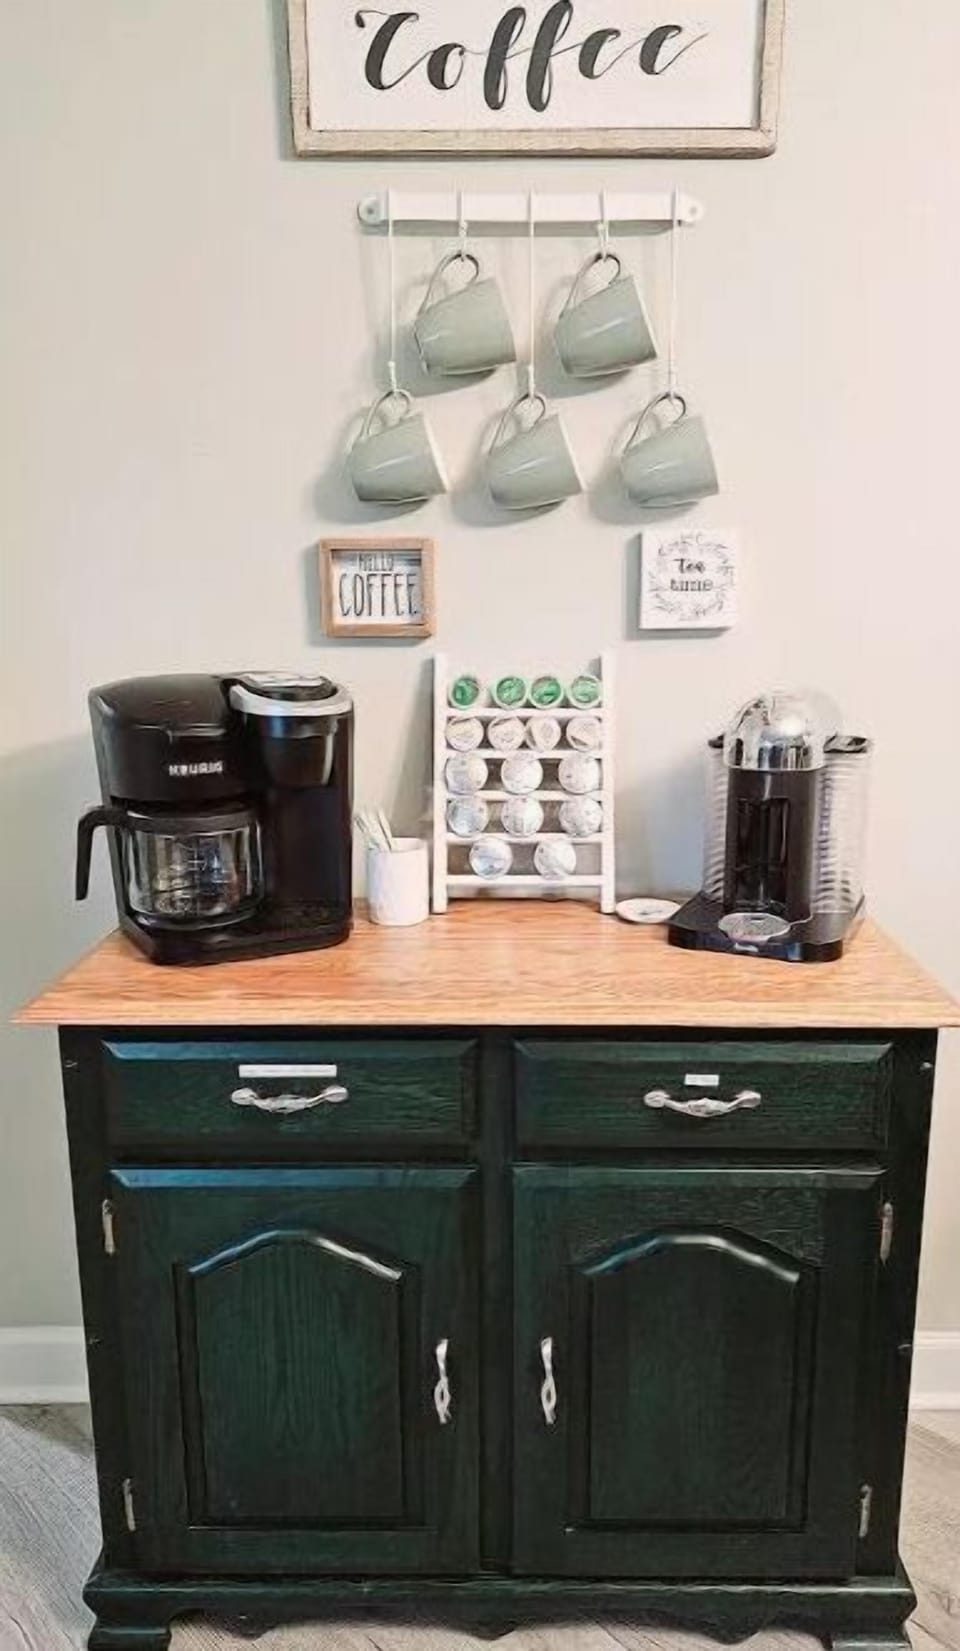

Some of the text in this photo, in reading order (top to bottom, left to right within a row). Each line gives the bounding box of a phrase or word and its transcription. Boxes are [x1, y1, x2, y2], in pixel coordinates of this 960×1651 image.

[355, 0, 708, 112] Coffee
[673, 558, 705, 574] Tea
[339, 573, 418, 616] COFFEE
